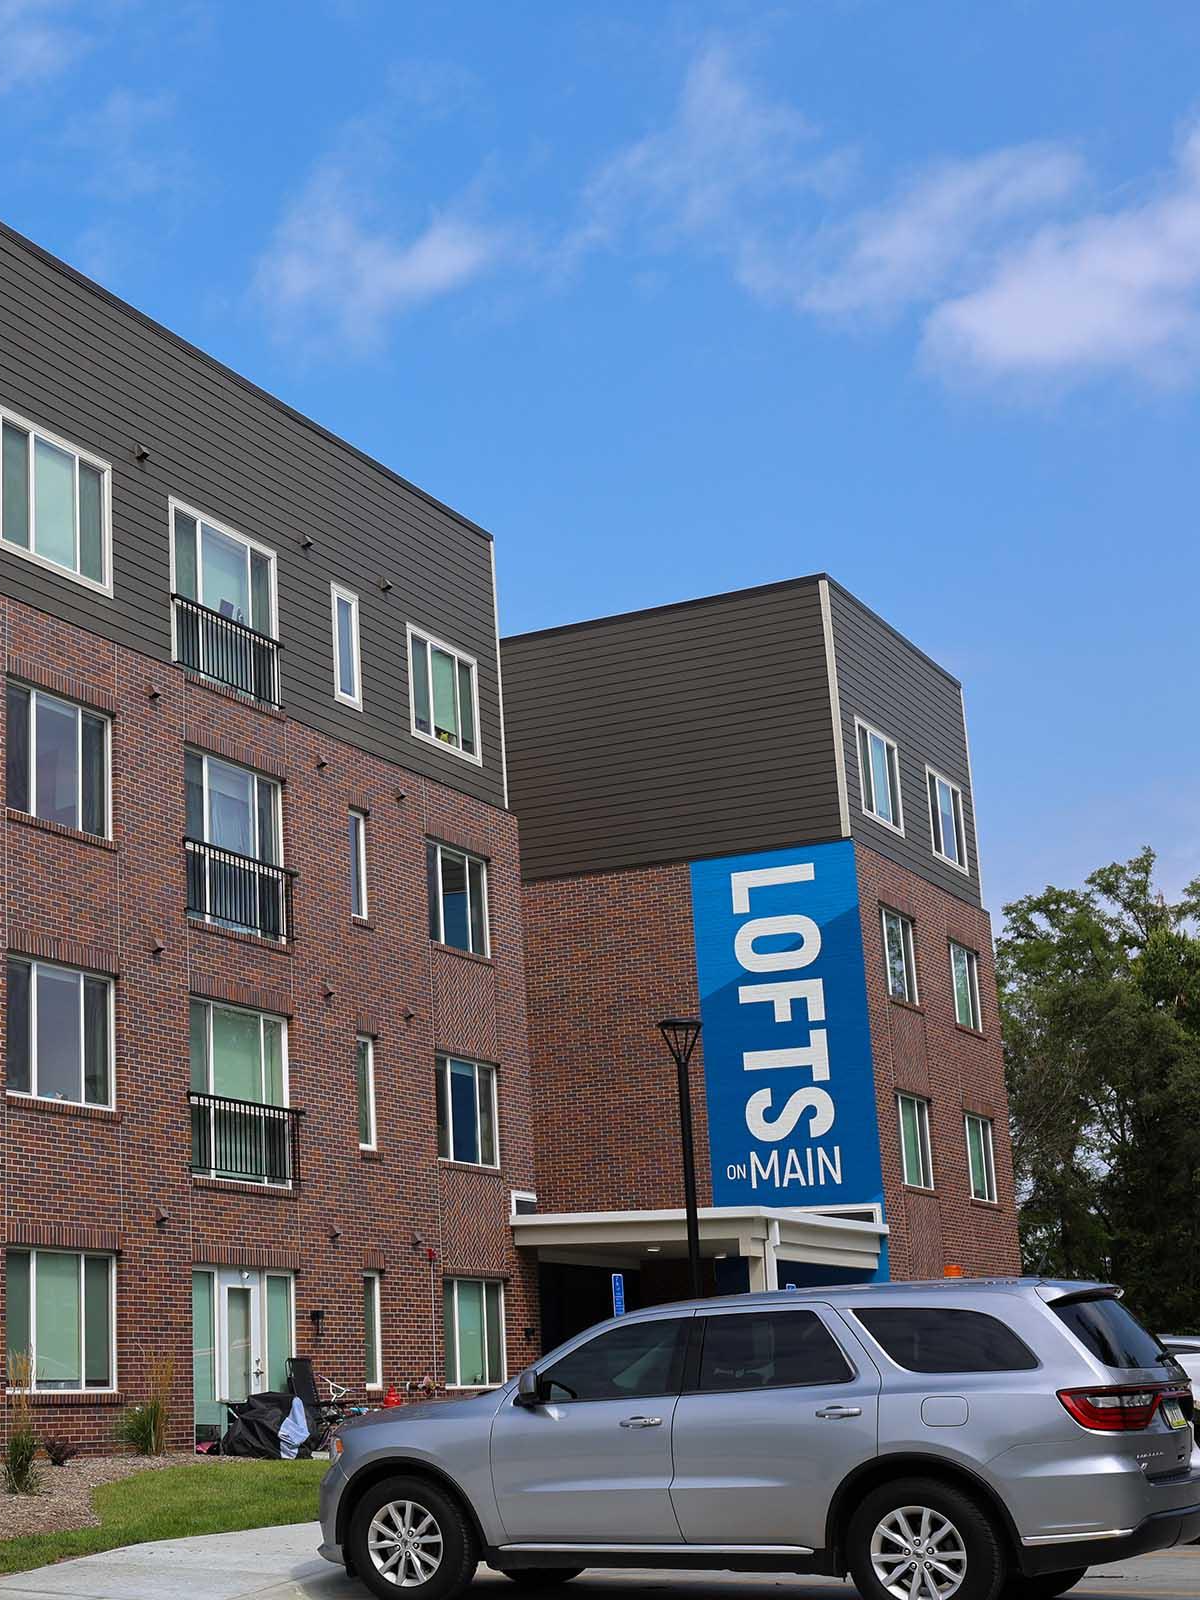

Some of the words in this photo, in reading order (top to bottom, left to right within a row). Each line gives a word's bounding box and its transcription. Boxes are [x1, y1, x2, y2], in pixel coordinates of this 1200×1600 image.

[731, 862, 835, 1142] LOFTS
[726, 1164, 747, 1180] ON
[749, 1145, 842, 1189] MAIN
